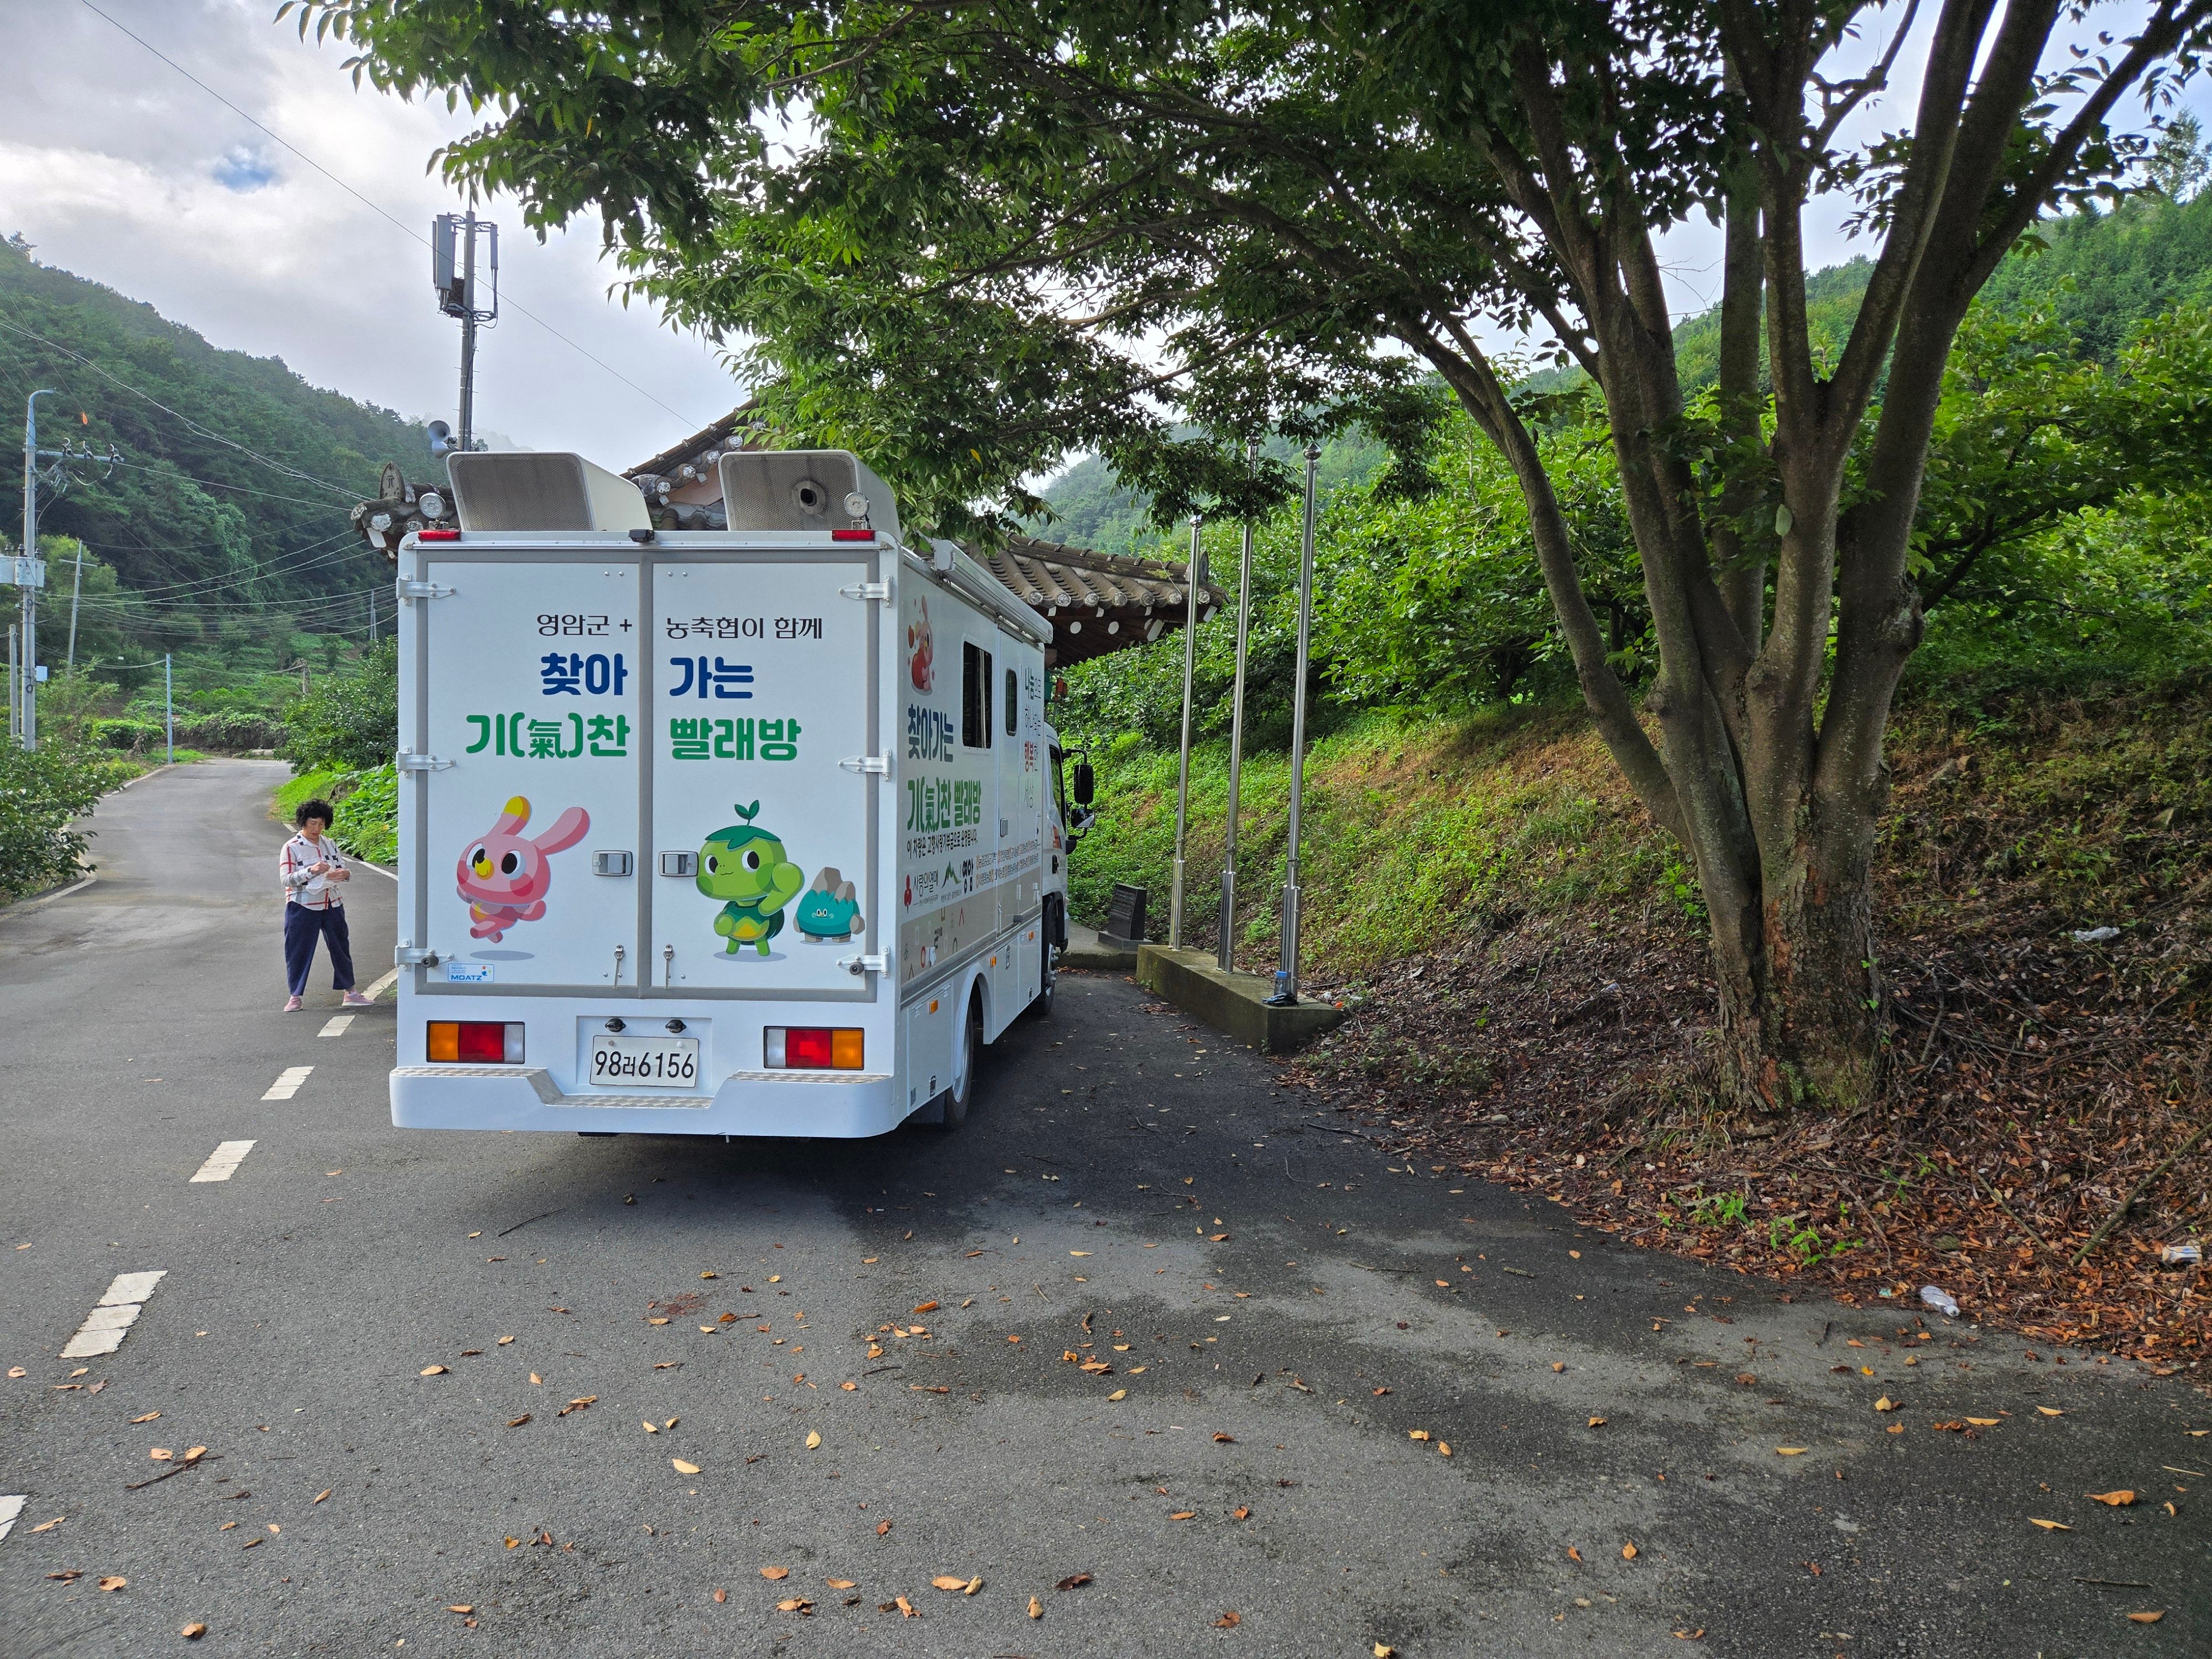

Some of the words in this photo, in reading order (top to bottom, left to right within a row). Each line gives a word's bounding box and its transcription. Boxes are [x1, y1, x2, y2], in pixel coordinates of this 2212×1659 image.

[536, 614, 610, 637] 영암군
[666, 617, 764, 639] 농축협이
[774, 617, 823, 640] 함께
[540, 653, 628, 696] 찾아
[669, 656, 754, 699] 가는
[466, 712, 630, 759] 기(氣)찬
[670, 717, 802, 761] 빨래방
[907, 703, 953, 763] 찾아가는
[1024, 740, 1039, 773] 행복한
[907, 776, 951, 834] 기(氣)찬
[954, 779, 982, 827] 빨래방
[907, 839, 912, 859] 이
[913, 836, 926, 859] 차량은
[927, 831, 961, 855] 고향사랑기부금으로
[913, 869, 938, 897] 사랑의열매
[595, 1051, 694, 1078] 98러6156
